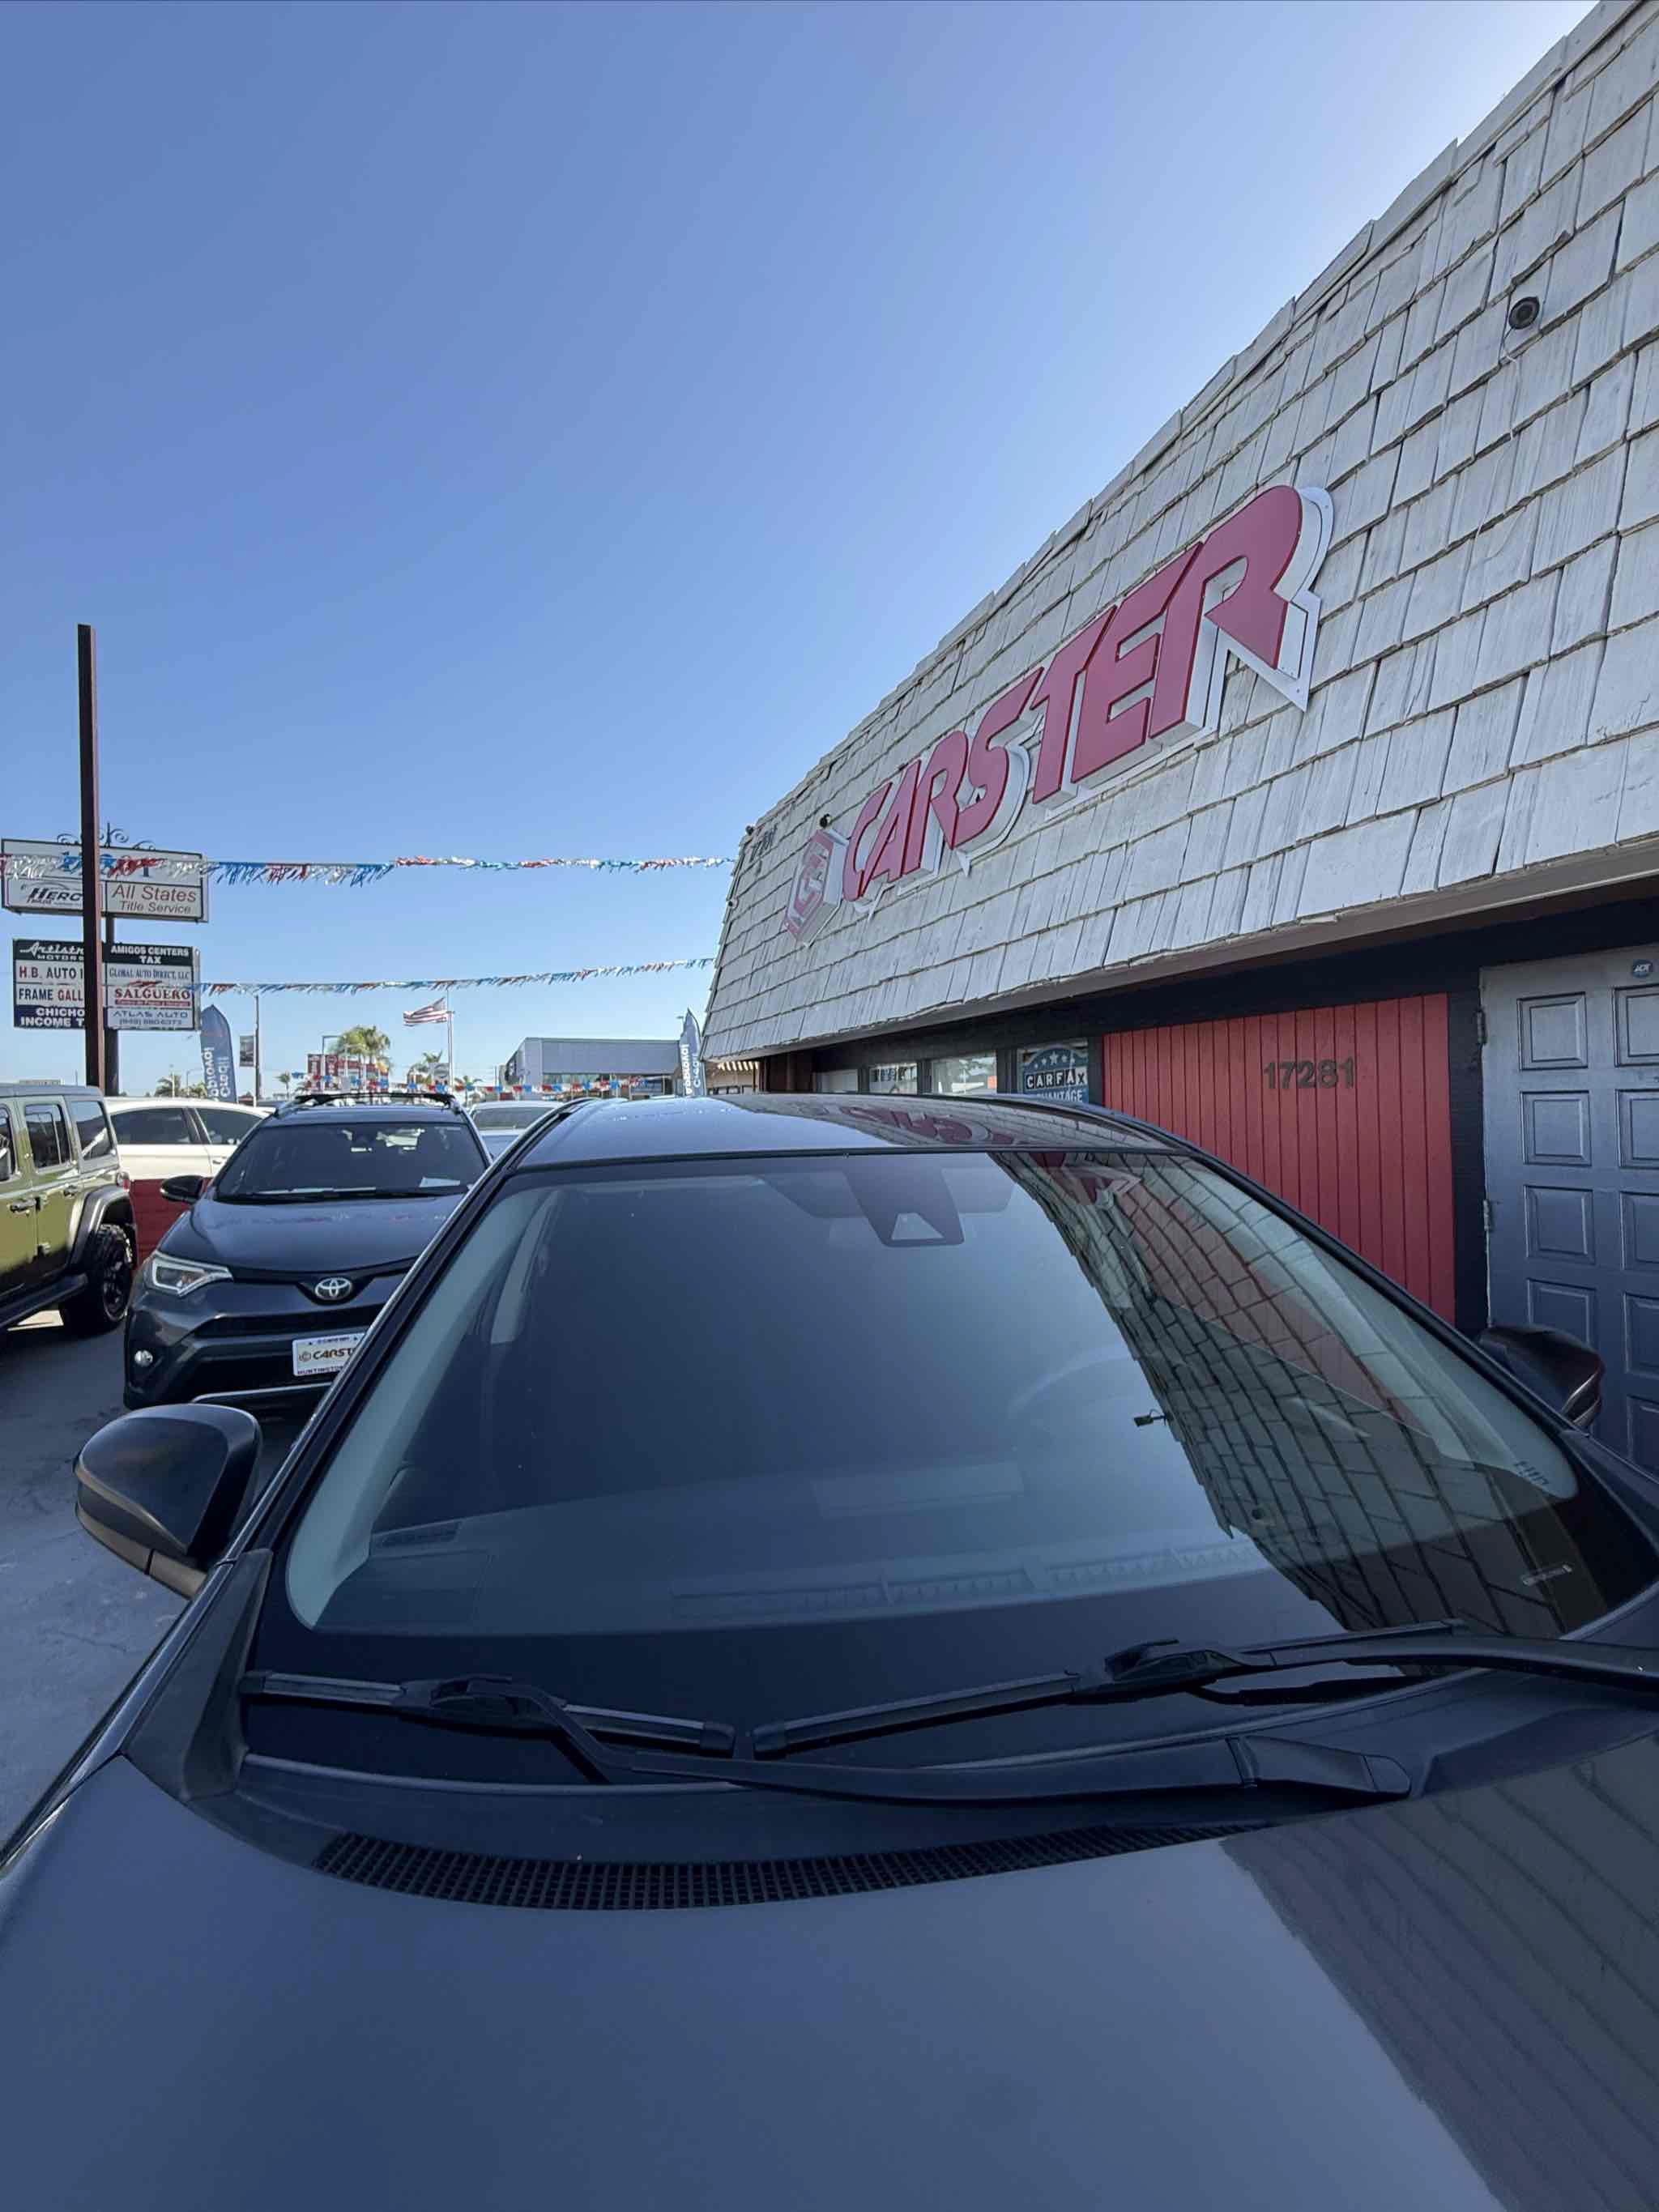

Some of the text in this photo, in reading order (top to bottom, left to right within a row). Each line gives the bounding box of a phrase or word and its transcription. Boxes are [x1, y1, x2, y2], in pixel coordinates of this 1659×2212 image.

[842, 484, 1316, 902] CARSTER
[112, 883, 196, 902] All States
[119, 900, 191, 914] Title Service
[111, 945, 189, 957] AMIGOS CENTERS
[139, 956, 161, 964] TAX
[46, 967, 76, 978] AUTO
[19, 988, 53, 1000] FRAME
[115, 988, 190, 999] SALGUERO
[113, 1010, 152, 1018] ATLAS
[20, 1016, 71, 1027] INCOME
[1263, 1057, 1354, 1089] 17281
[1026, 1070, 1087, 1089] CARFAX
